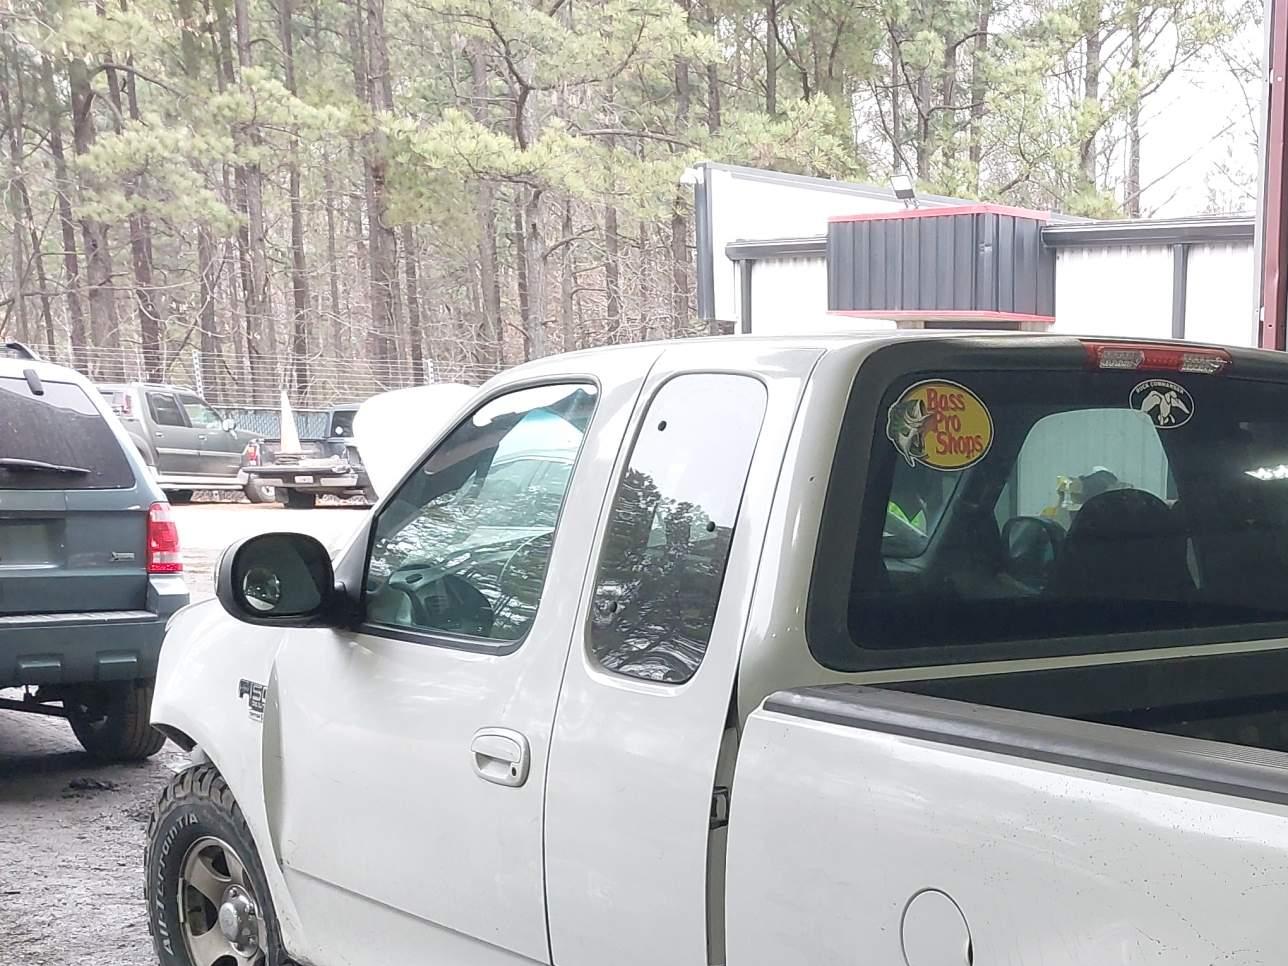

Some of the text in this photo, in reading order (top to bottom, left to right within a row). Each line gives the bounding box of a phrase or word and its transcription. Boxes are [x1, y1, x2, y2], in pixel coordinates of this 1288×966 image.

[926, 388, 966, 412] Bass
[935, 409, 962, 433] Pro
[936, 431, 983, 459] Shops
